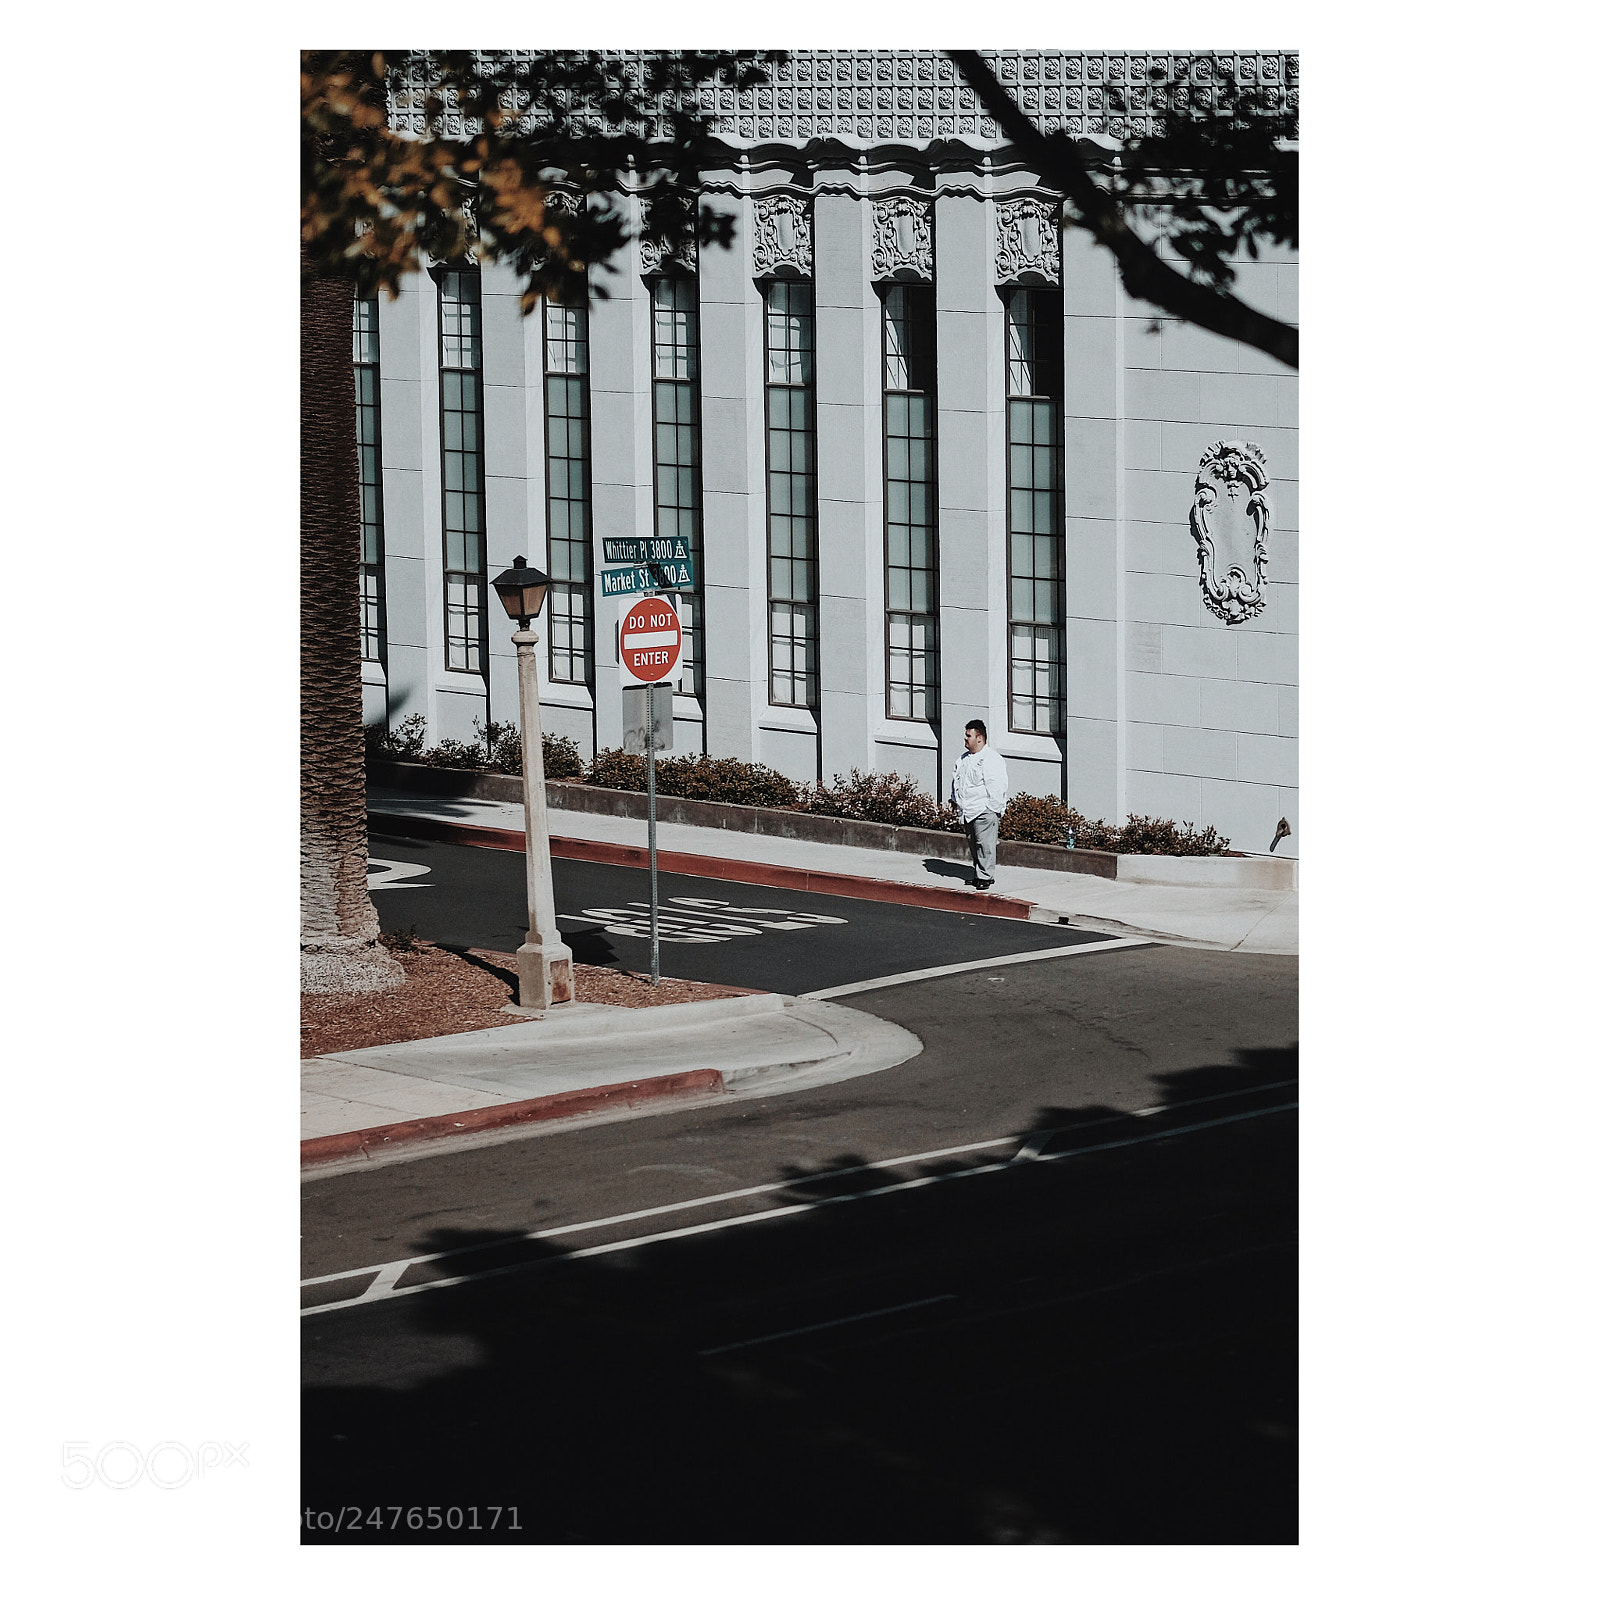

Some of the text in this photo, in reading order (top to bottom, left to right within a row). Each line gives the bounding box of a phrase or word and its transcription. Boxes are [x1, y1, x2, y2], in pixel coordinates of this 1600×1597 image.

[605, 539, 673, 560] Whittier Pl 3800
[604, 569, 636, 593] Market
[638, 568, 650, 588] St
[629, 613, 673, 629] DO NOT
[633, 651, 669, 667] ENTER
